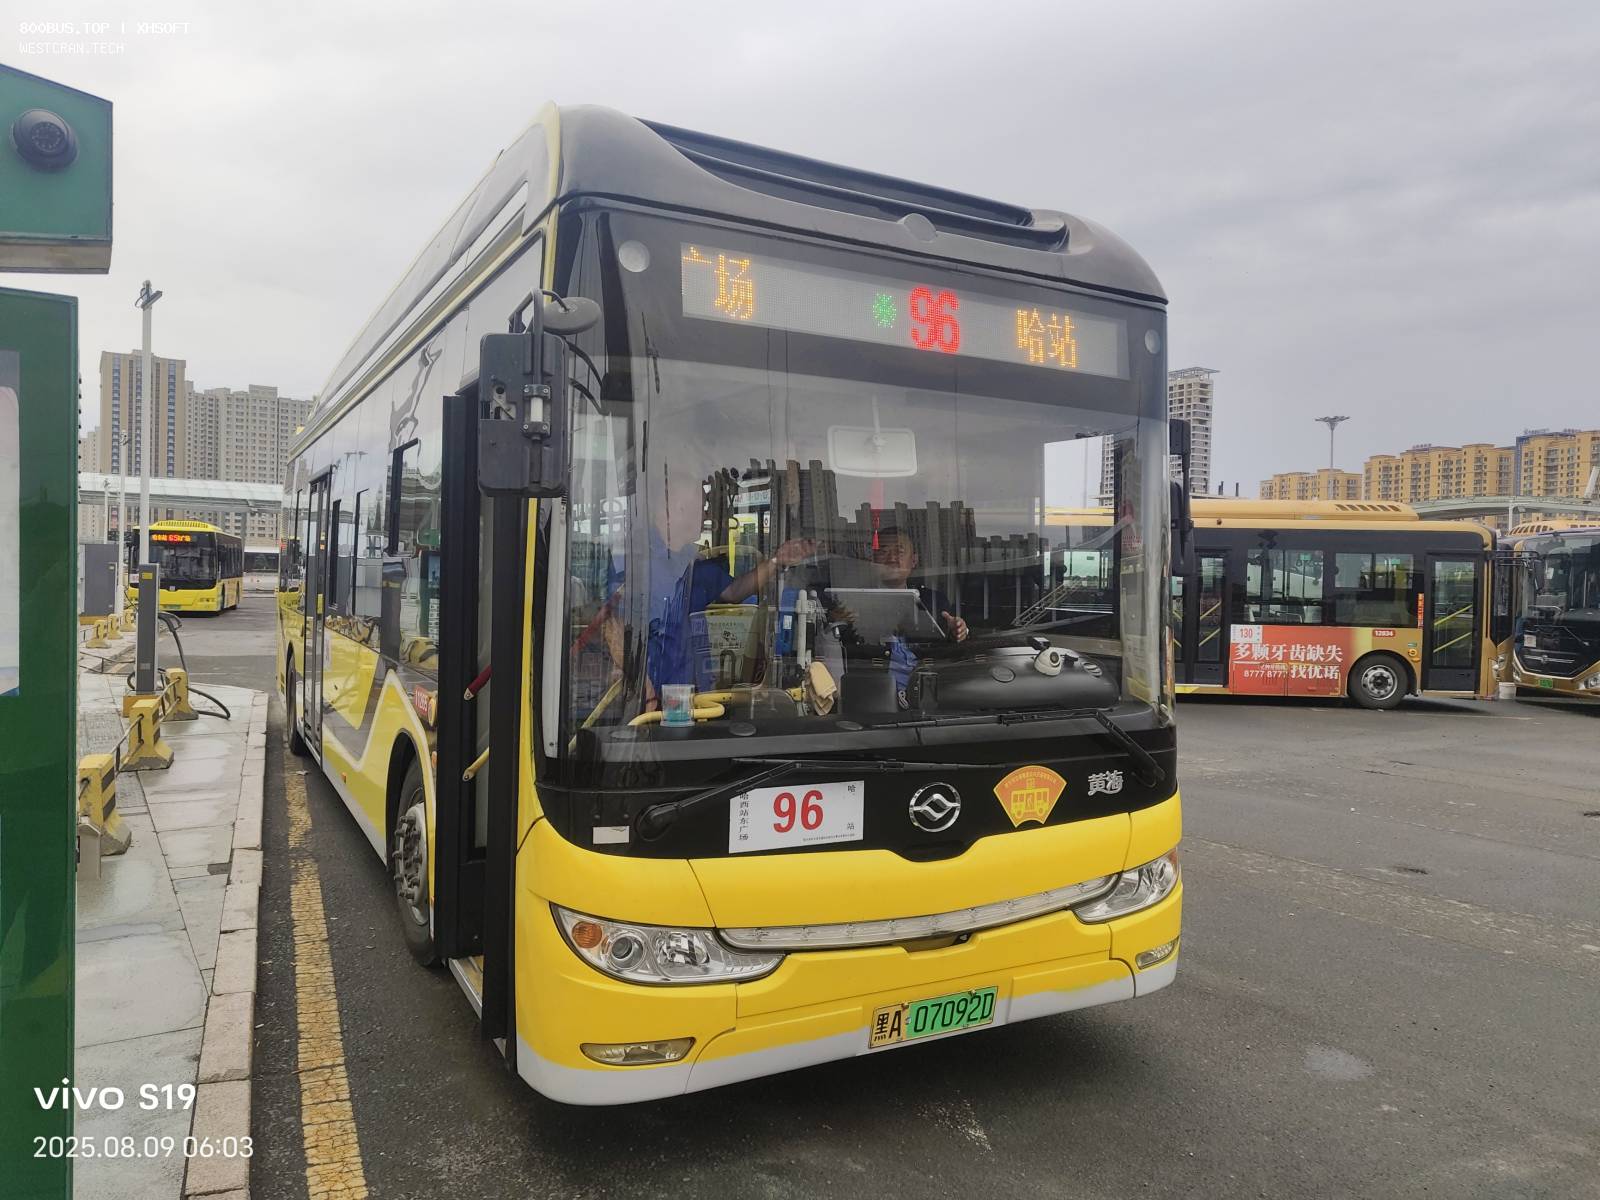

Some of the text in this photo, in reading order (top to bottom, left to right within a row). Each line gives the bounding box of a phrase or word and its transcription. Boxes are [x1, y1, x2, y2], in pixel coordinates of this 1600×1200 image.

[909, 287, 960, 354] 96
[1017, 307, 1077, 369] 哈站
[1240, 627, 1253, 639] 130
[1232, 643, 1343, 663] 多颗牙齿缺失
[1243, 670, 1265, 678] 8777
[1290, 665, 1340, 680] 找优诺
[773, 790, 824, 833] 96
